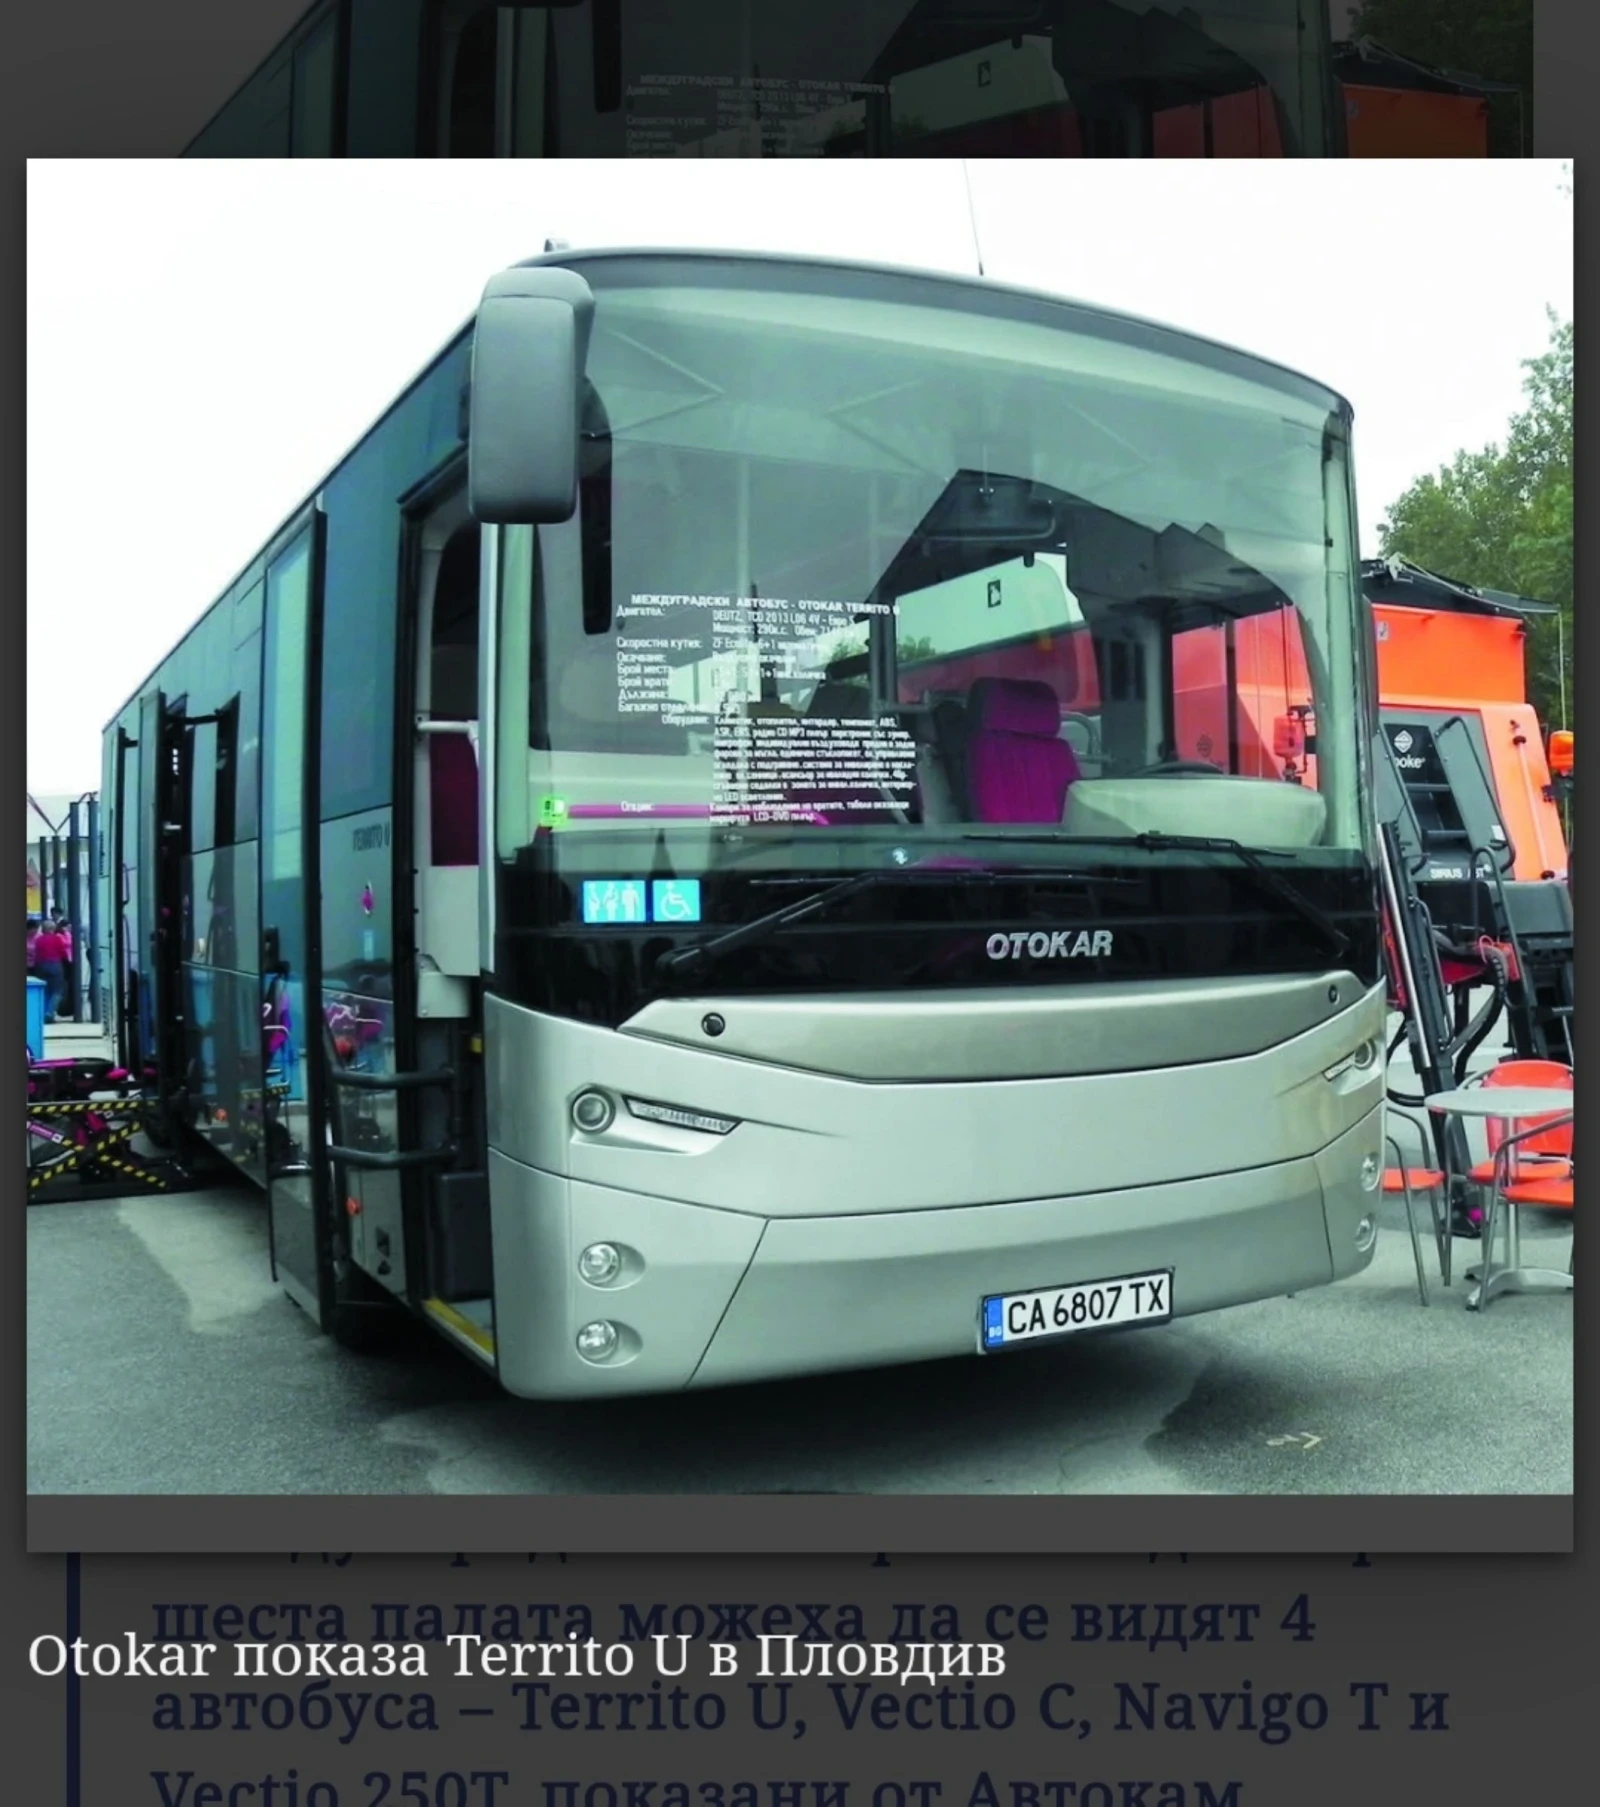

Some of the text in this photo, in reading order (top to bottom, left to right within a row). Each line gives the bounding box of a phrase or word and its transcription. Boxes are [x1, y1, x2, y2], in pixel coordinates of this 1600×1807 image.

[630, 594, 730, 608] МЕЖДУГРАДСКИ
[736, 597, 789, 611] АВТОБУС
[798, 599, 843, 612] OTOKAR
[845, 602, 891, 615] TERRITO
[616, 636, 669, 650] Скоростна
[618, 664, 642, 677] Брой
[618, 676, 642, 689] Брой
[986, 929, 1114, 960] OTOKAR
[1008, 1279, 1164, 1334] CA 6807 TX
